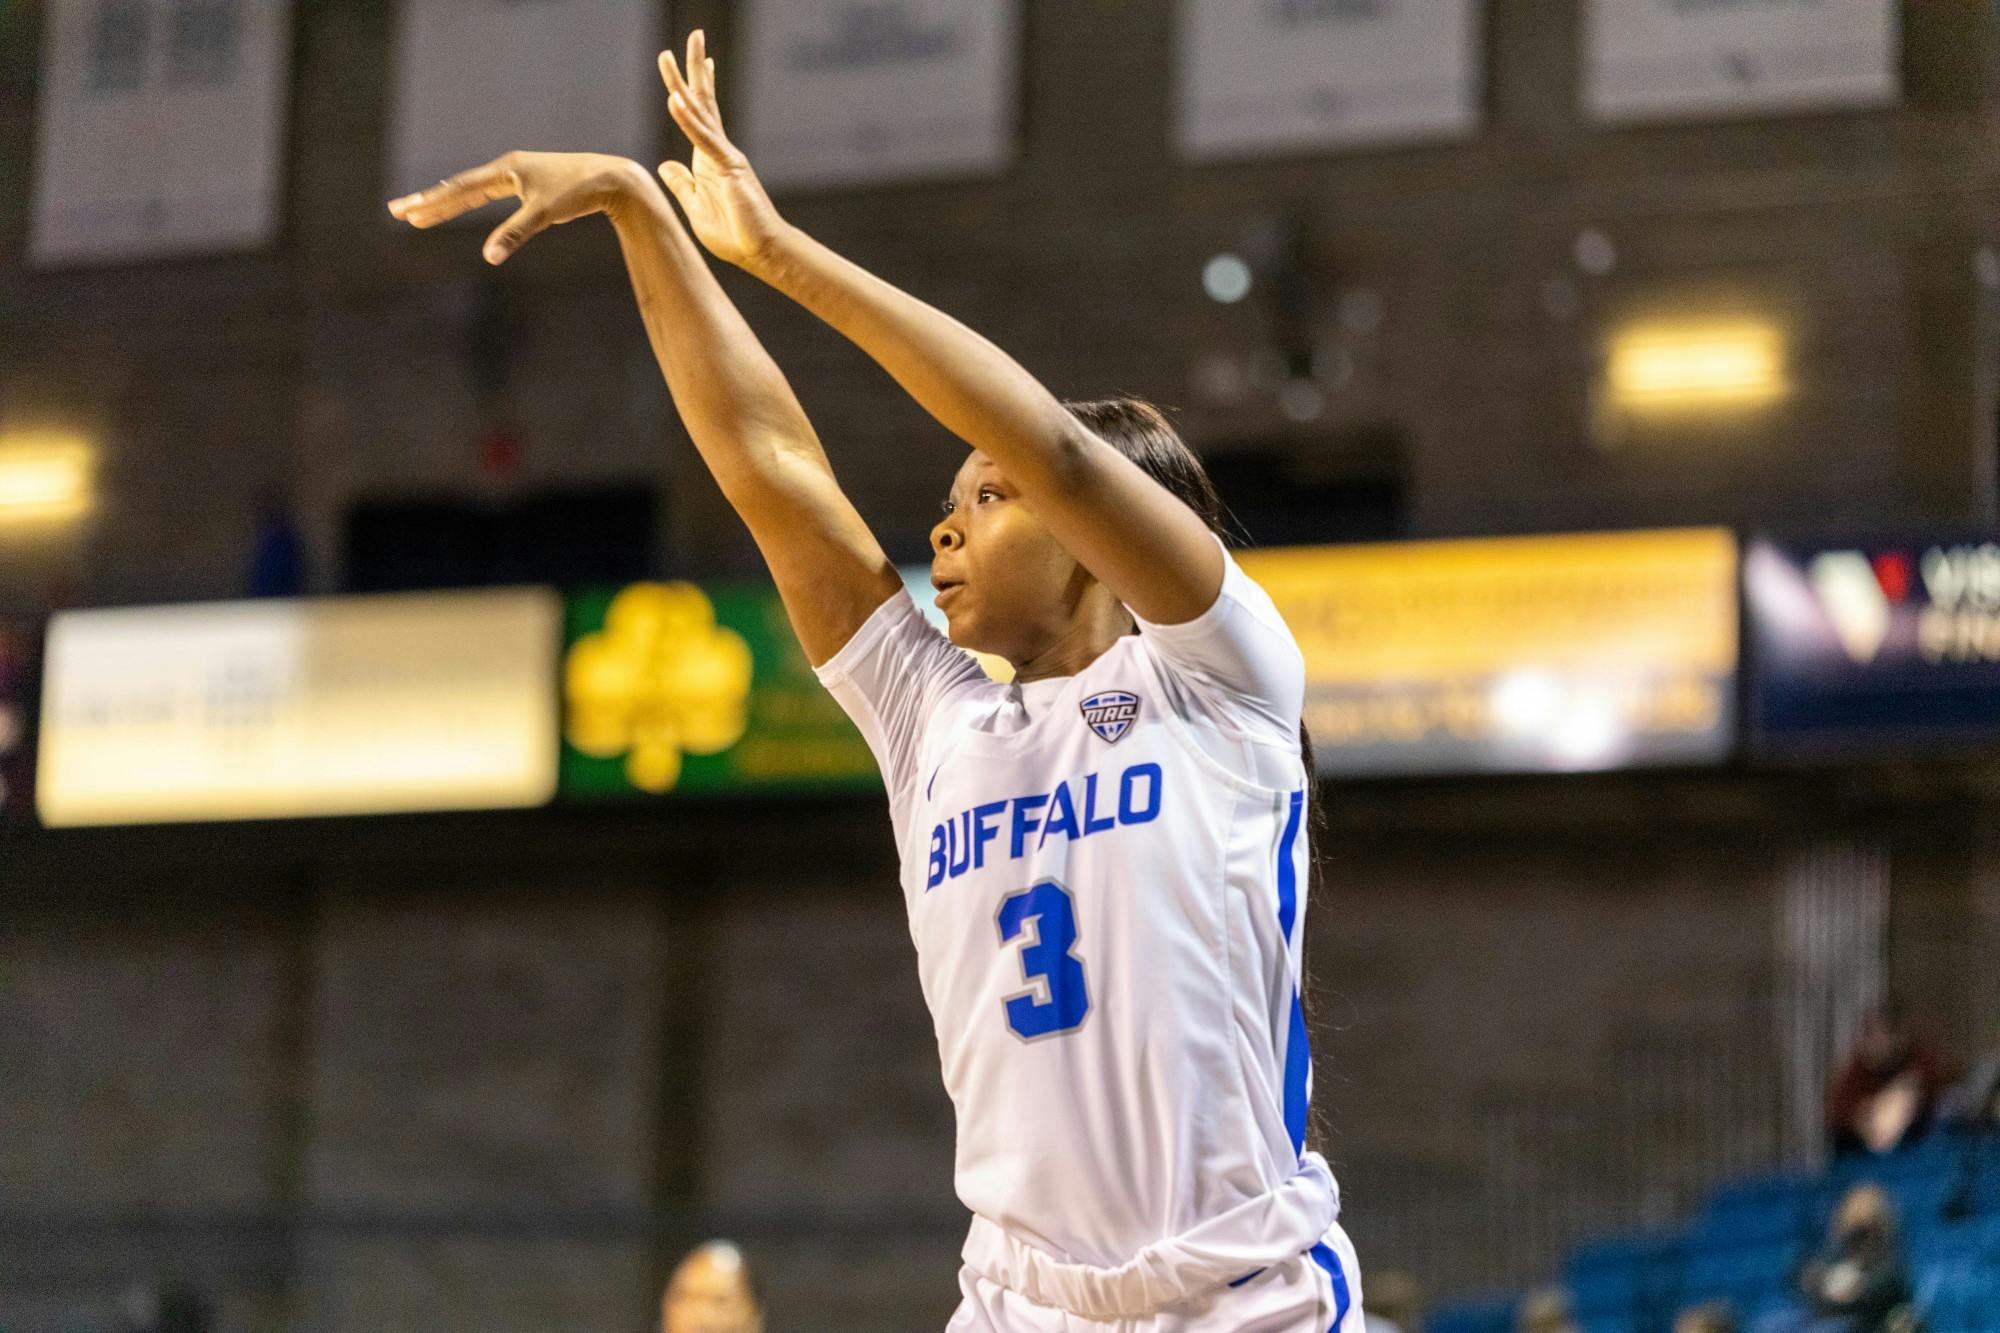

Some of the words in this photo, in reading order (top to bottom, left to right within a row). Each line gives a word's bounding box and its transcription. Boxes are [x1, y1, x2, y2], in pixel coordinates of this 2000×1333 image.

[1083, 705, 1137, 723] MAC
[926, 762, 1163, 893] BUFFALO
[994, 877, 1094, 1044] 3
